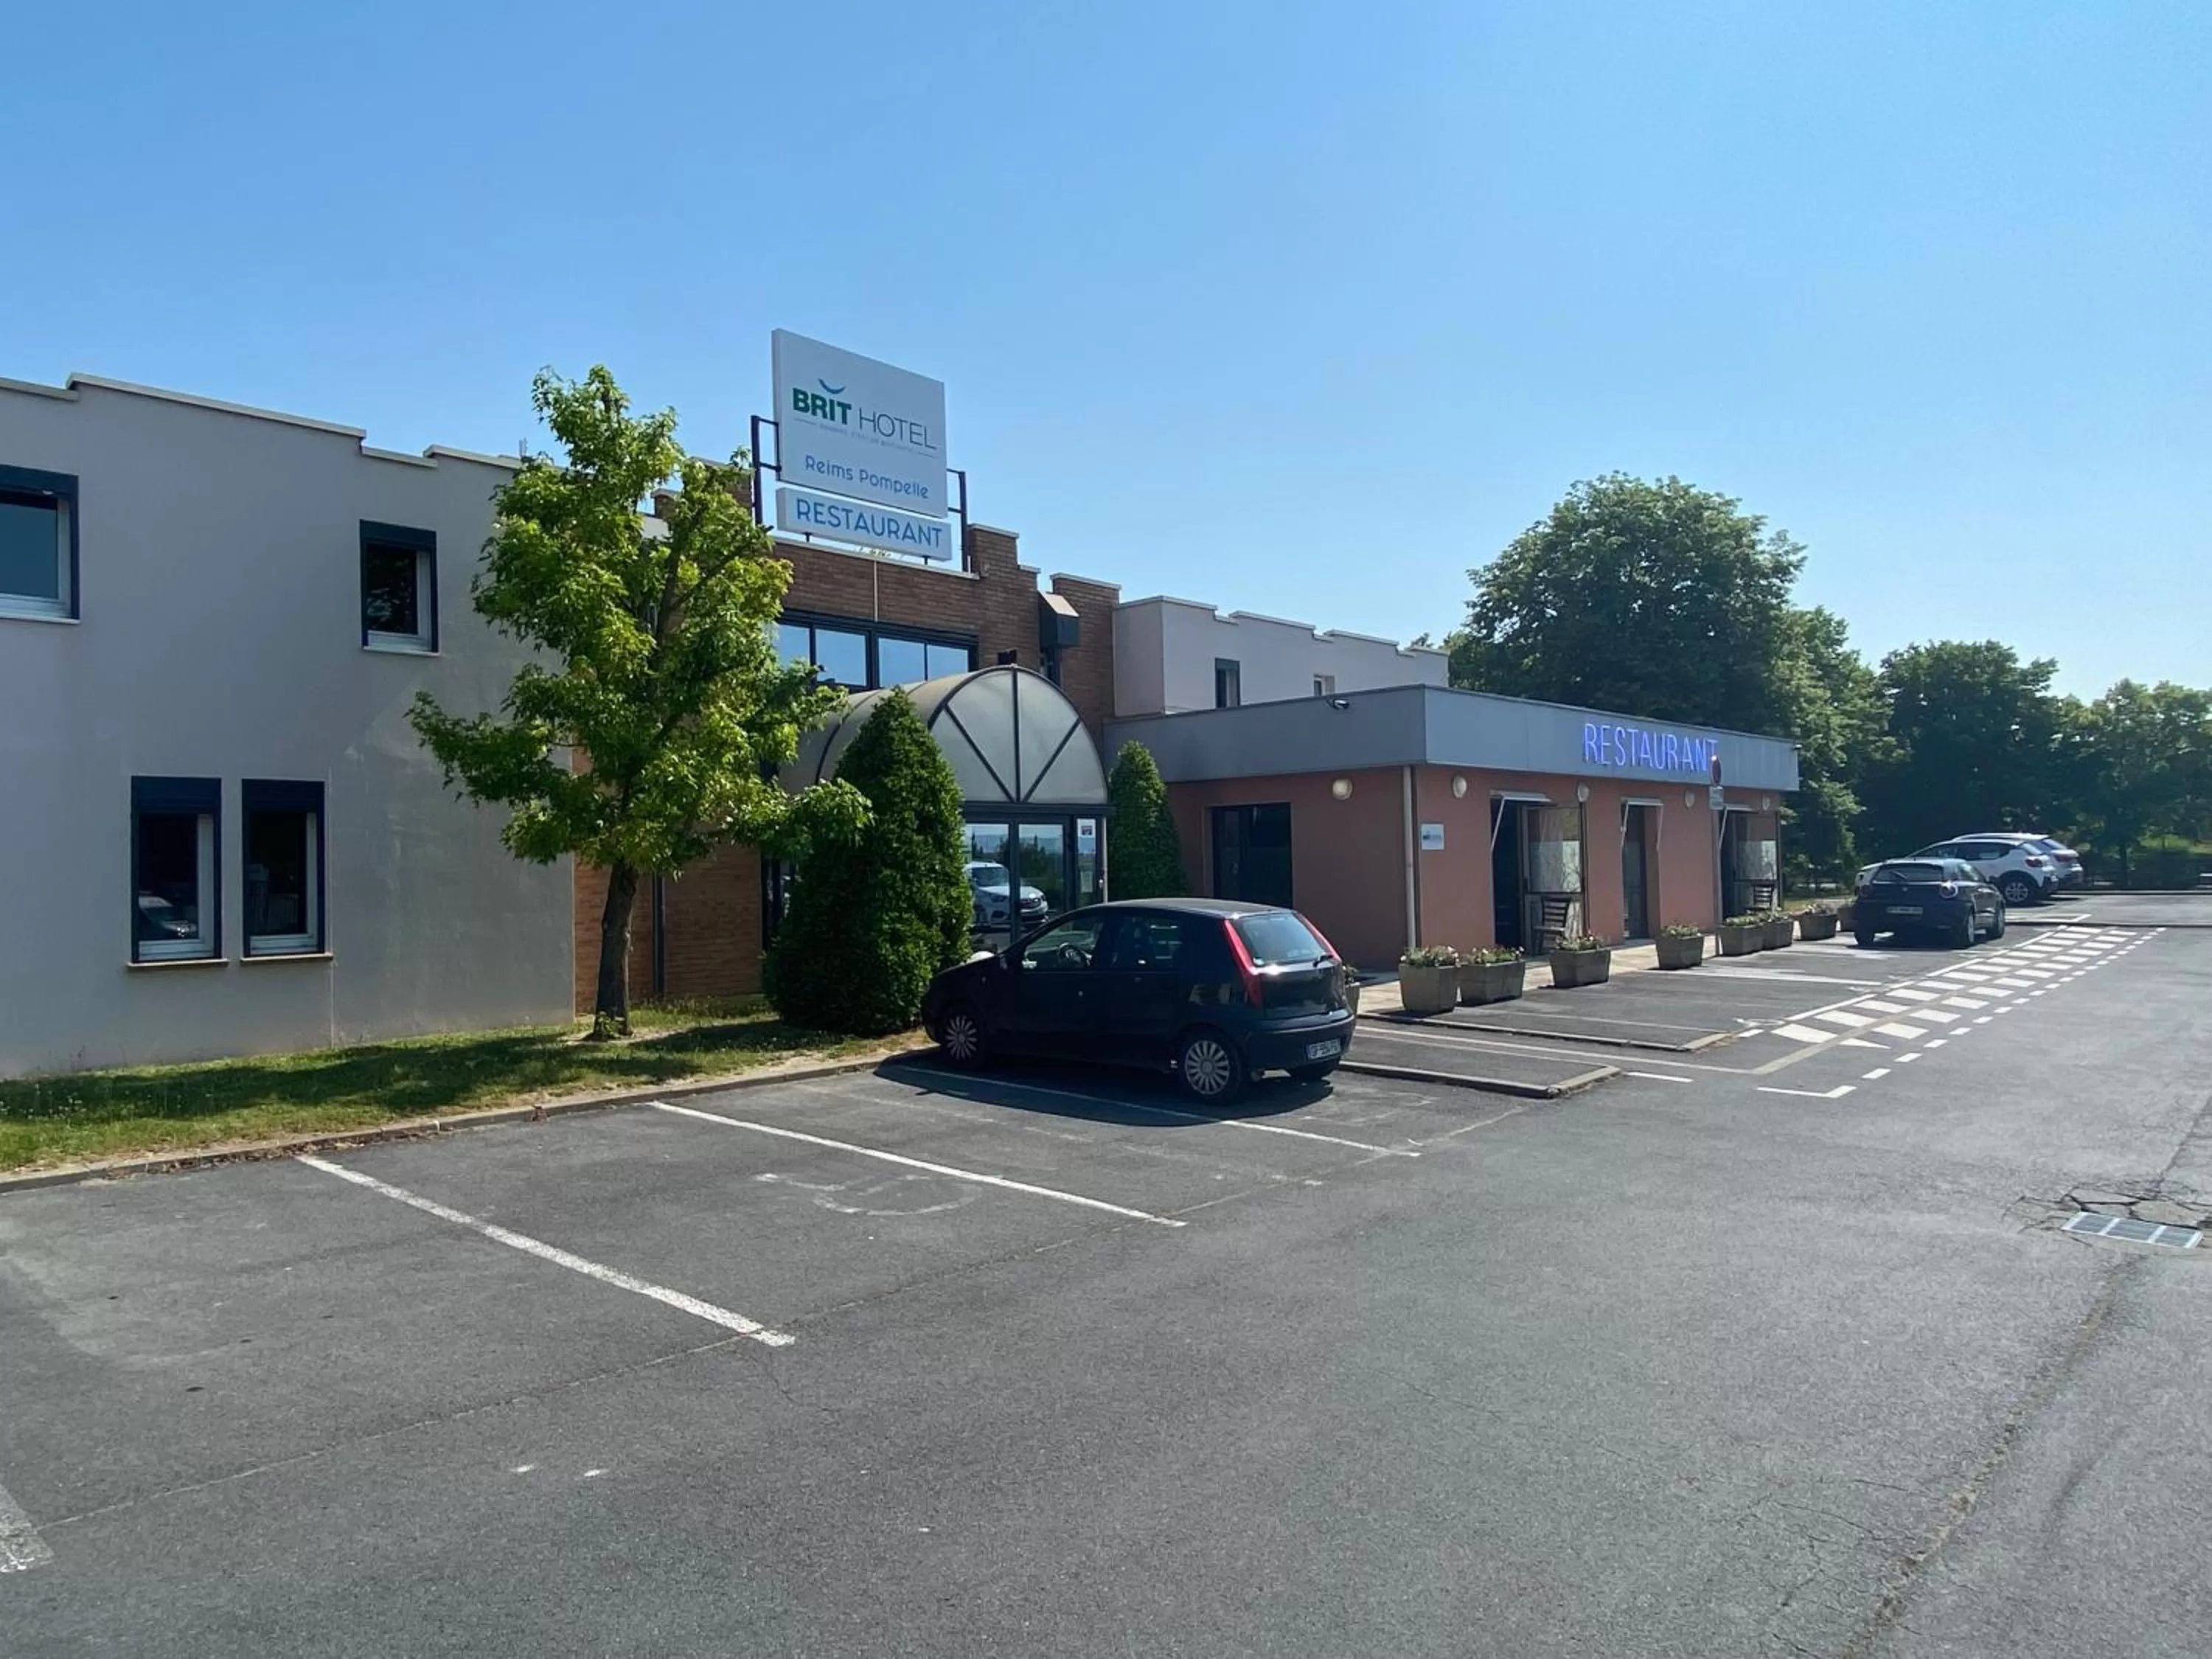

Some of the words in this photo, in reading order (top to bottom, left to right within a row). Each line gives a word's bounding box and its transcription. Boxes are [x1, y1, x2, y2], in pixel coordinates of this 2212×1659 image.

[793, 387, 852, 425] BRIT
[859, 407, 936, 451] HOTEL
[805, 455, 853, 481] Reims
[860, 469, 929, 500] Pompelle
[797, 498, 943, 549] RESTAURANT
[1584, 723, 1719, 772] RESTAURANT
